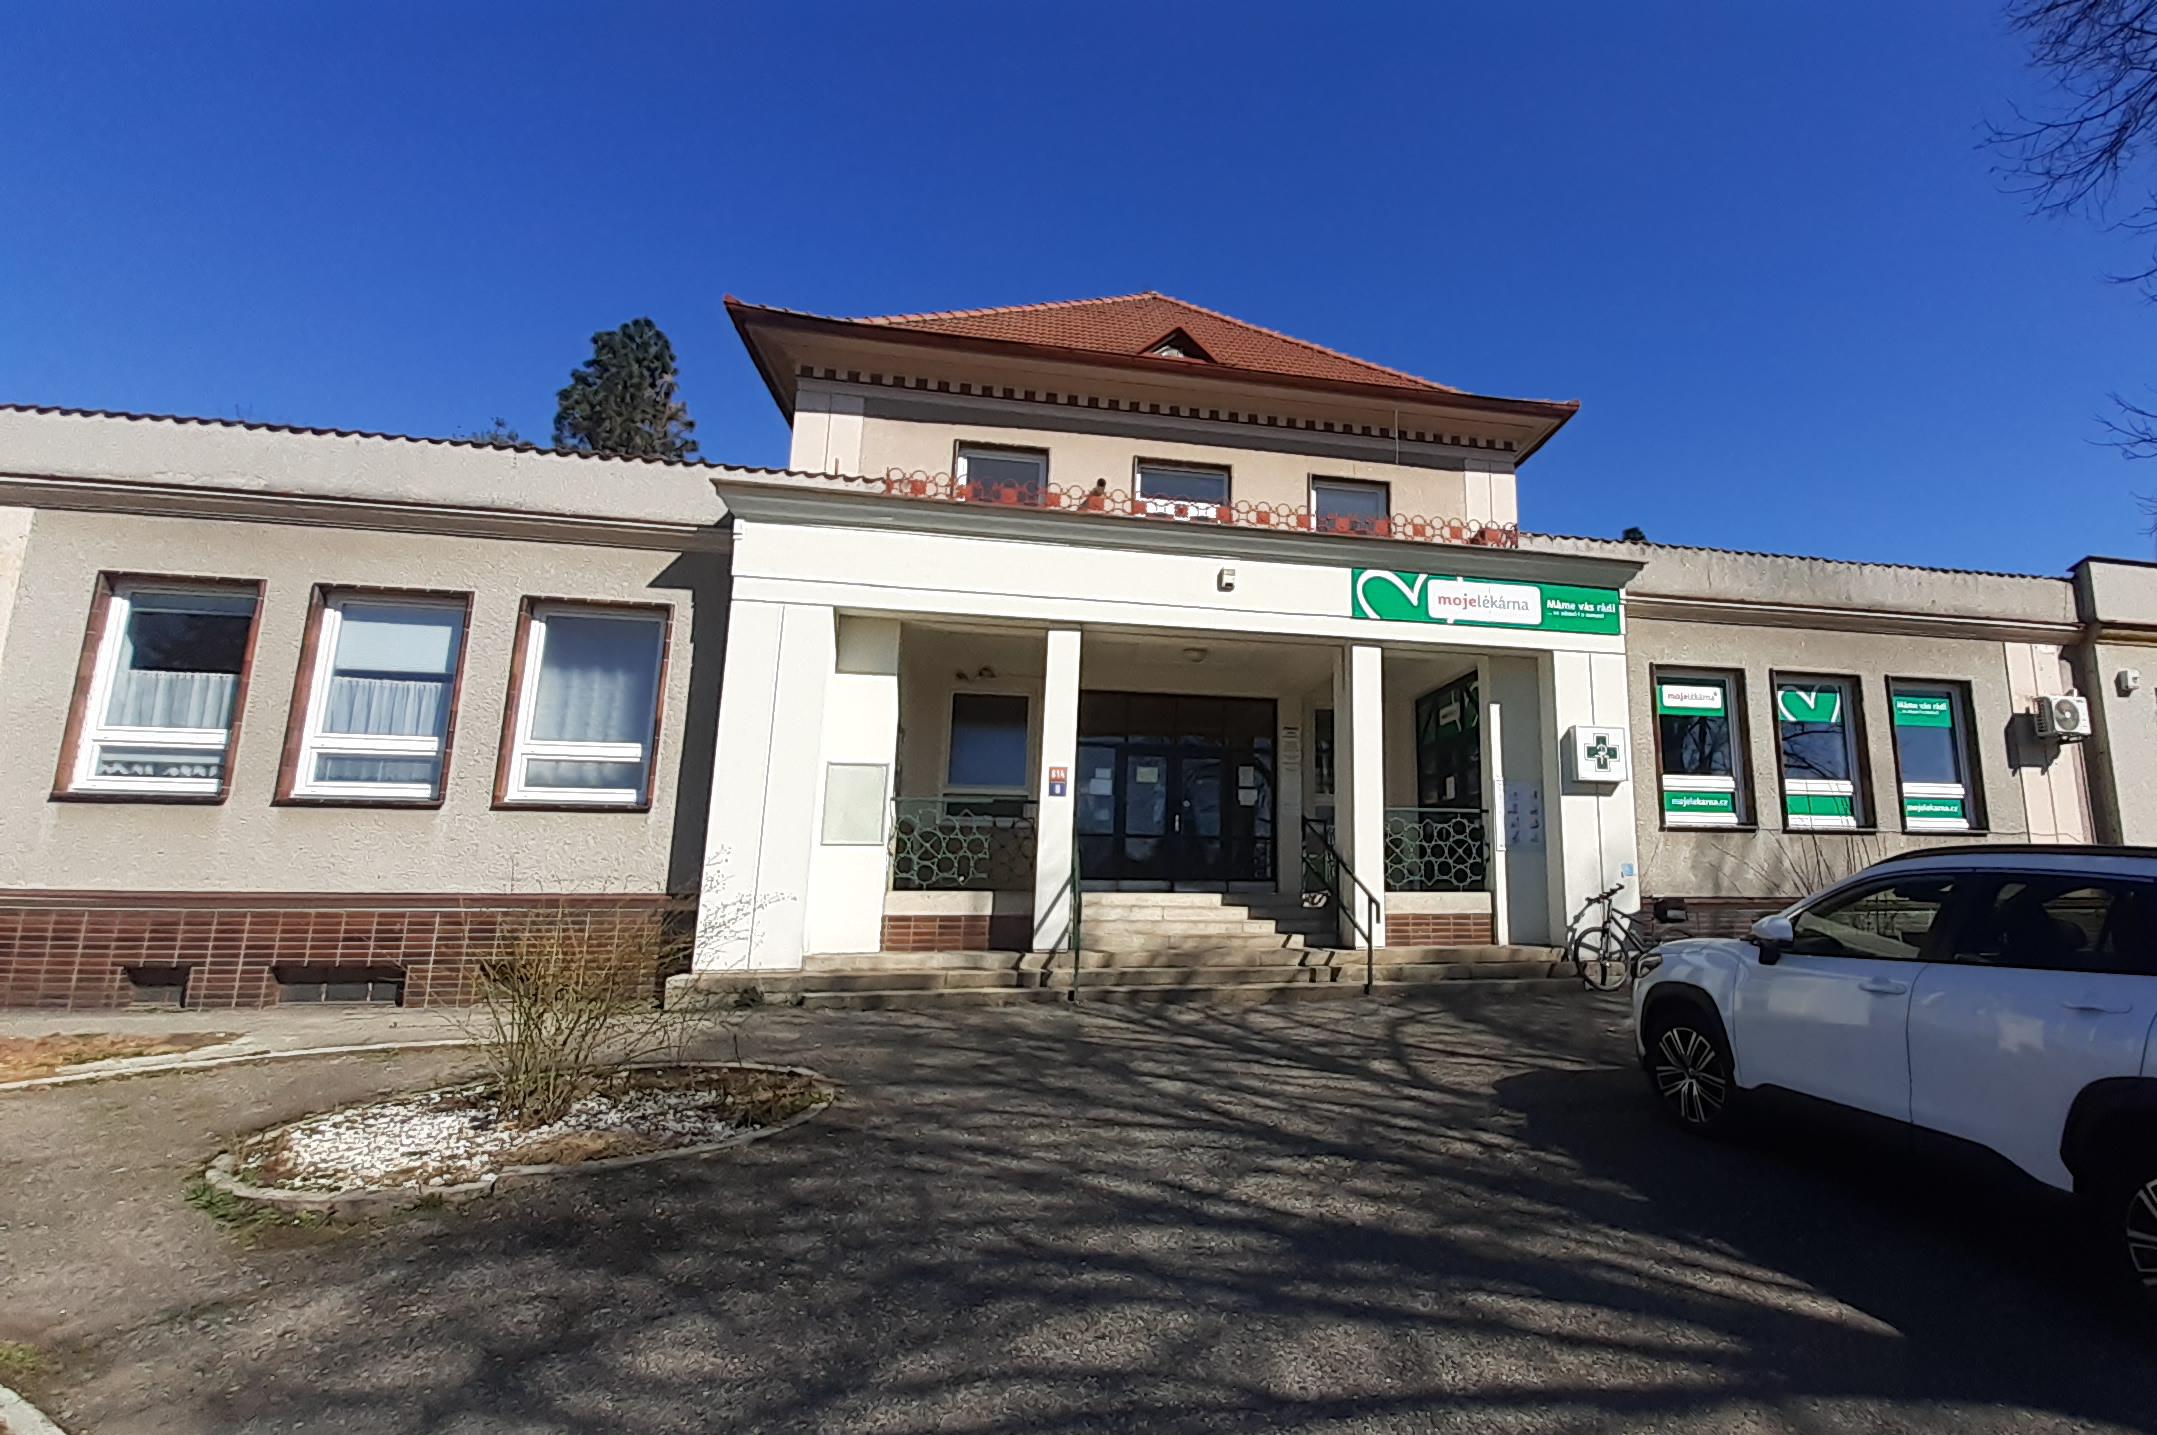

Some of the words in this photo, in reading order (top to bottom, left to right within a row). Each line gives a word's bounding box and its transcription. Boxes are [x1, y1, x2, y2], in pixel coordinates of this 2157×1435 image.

[1546, 599, 1576, 610] Máme
[1577, 602, 1595, 612] vás
[1596, 602, 1616, 613] rádi
